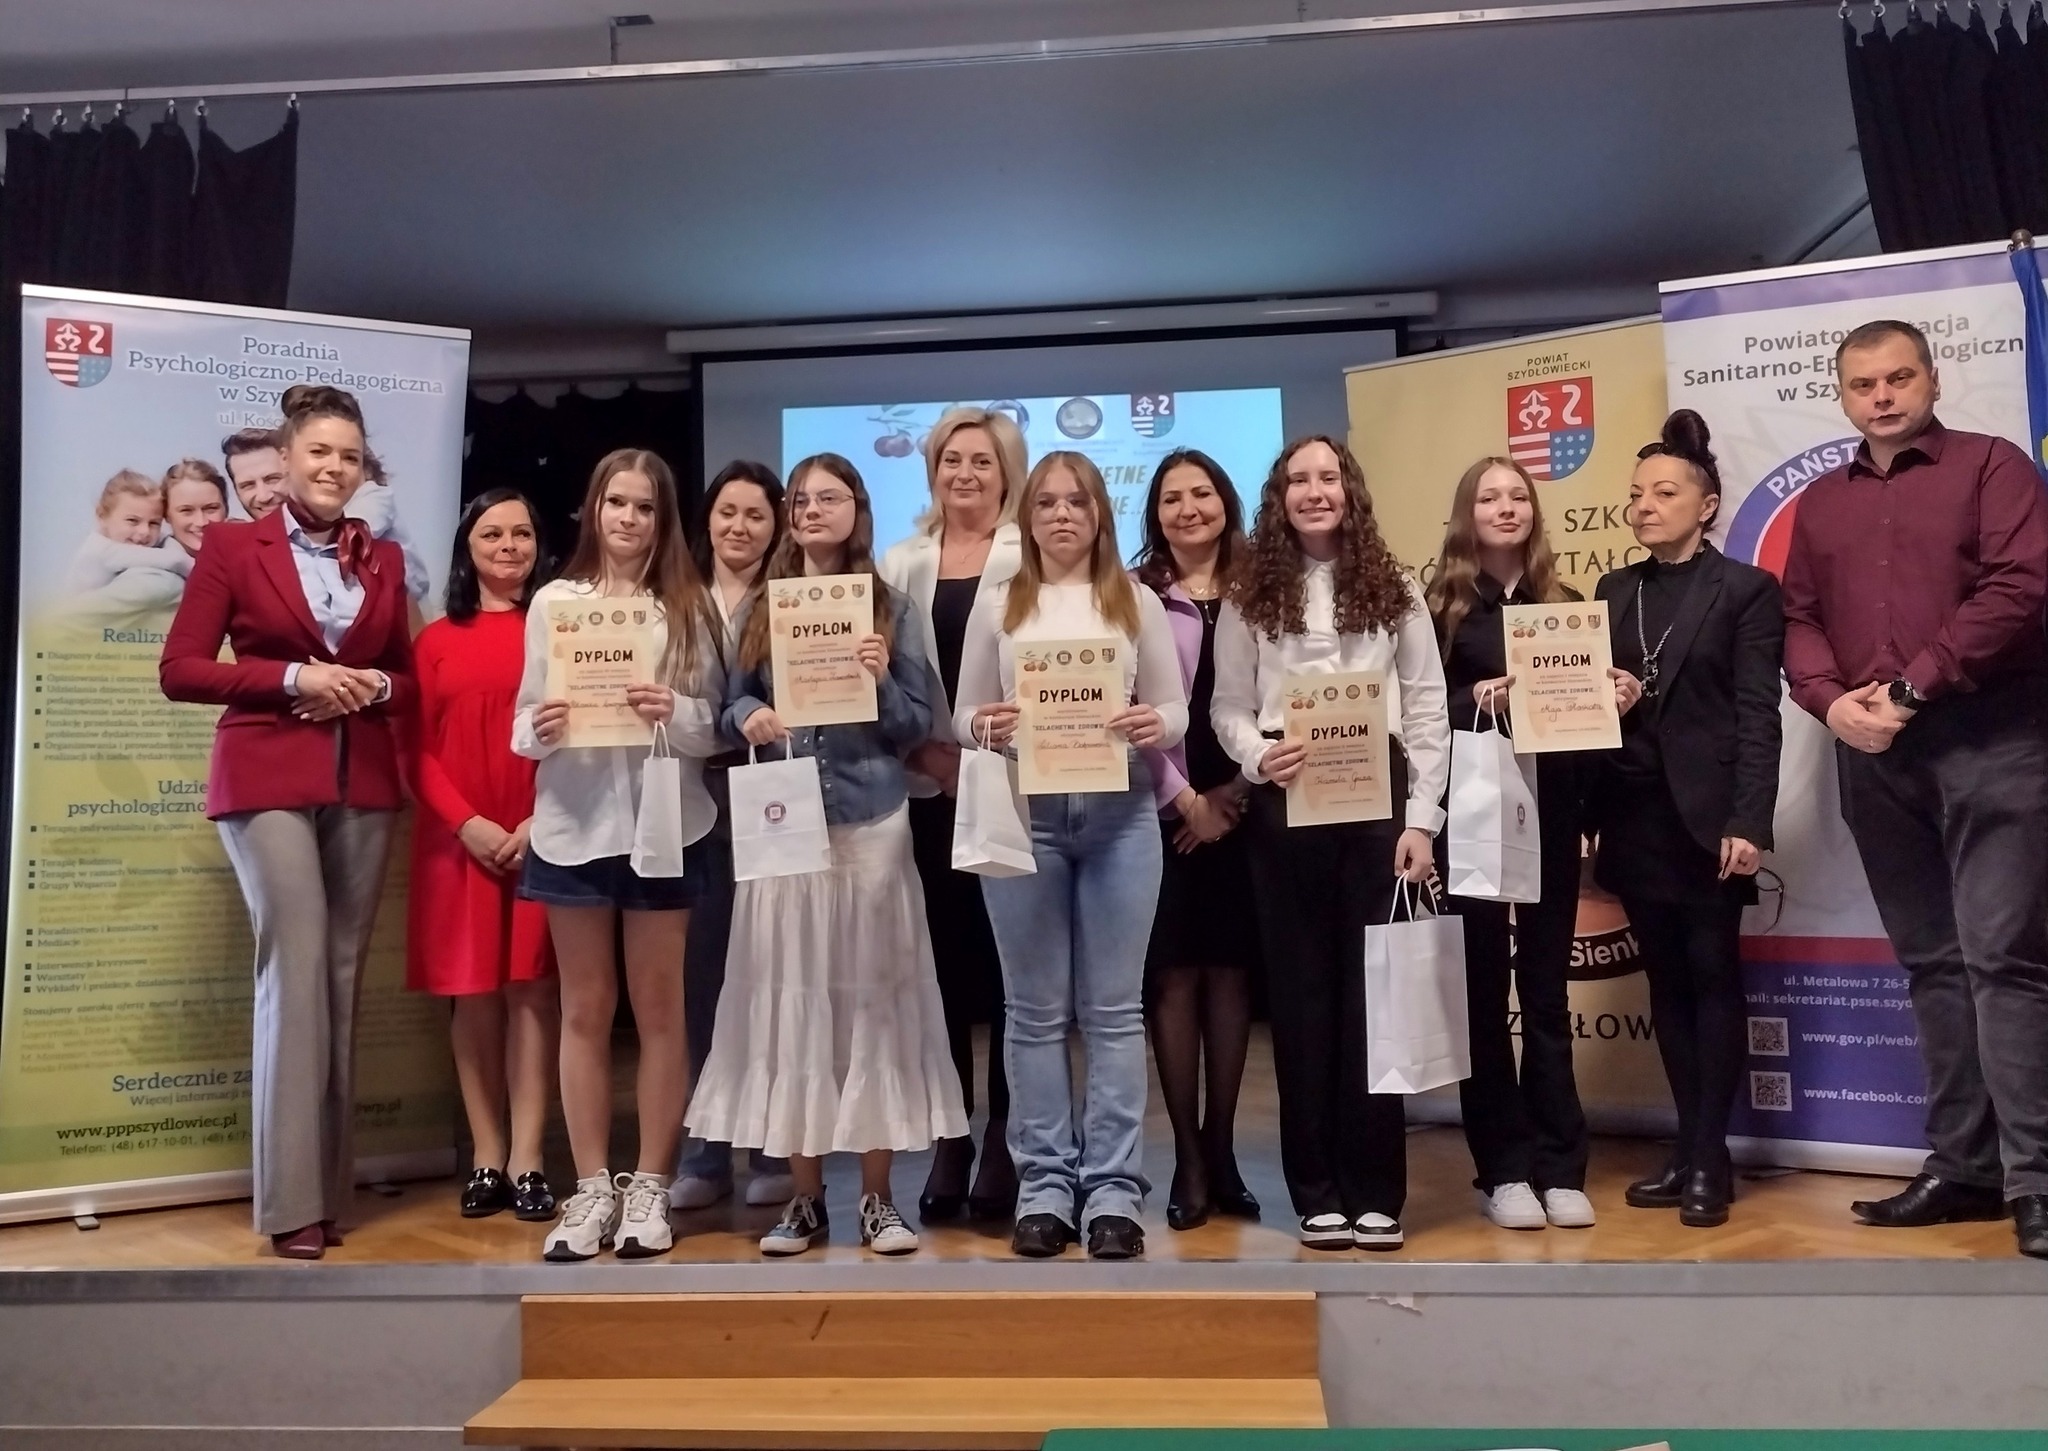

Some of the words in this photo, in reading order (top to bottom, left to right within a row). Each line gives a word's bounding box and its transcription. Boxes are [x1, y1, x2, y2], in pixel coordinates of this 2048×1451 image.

[243, 336, 339, 361] Poradnia
[1744, 329, 1851, 353] Powiato
[1527, 352, 1568, 366] POWIAT
[128, 350, 444, 394] Psychologiczno-Pedagogiczna
[1507, 360, 1591, 380] SZYDŁOWIECKI
[219, 387, 239, 400] w
[246, 385, 283, 407] Szy
[1777, 387, 1798, 401] w
[1805, 380, 1842, 401] Szy
[1766, 441, 1859, 499] PAŃST
[103, 628, 169, 644] Realizu
[793, 622, 852, 638] DYPLOM
[575, 649, 633, 663] DYPLOM
[1533, 654, 1591, 668] DYPLOM
[1040, 688, 1102, 703] DYPLOM
[1312, 724, 1369, 740] DYPLOM
[158, 780, 209, 795] Udzie
[67, 799, 208, 817] psychologiczno
[1784, 976, 1799, 986] ul.
[1803, 975, 1868, 988] Metalowa
[1872, 977, 1879, 988] 7
[1883, 978, 1910, 990] 26-5
[1773, 993, 1912, 1011] sekretariat.psse.szyd
[1802, 1032, 1918, 1046] www.gov.pl/web/
[112, 1068, 228, 1092] Serdecznie
[233, 1070, 253, 1084] za
[1804, 1088, 1926, 1105] www.facebook.co
[56, 1112, 238, 1140] www.pppszydlowiec.pl
[60, 1144, 107, 1156] Telefon:
[111, 1139, 134, 1153] (48)
